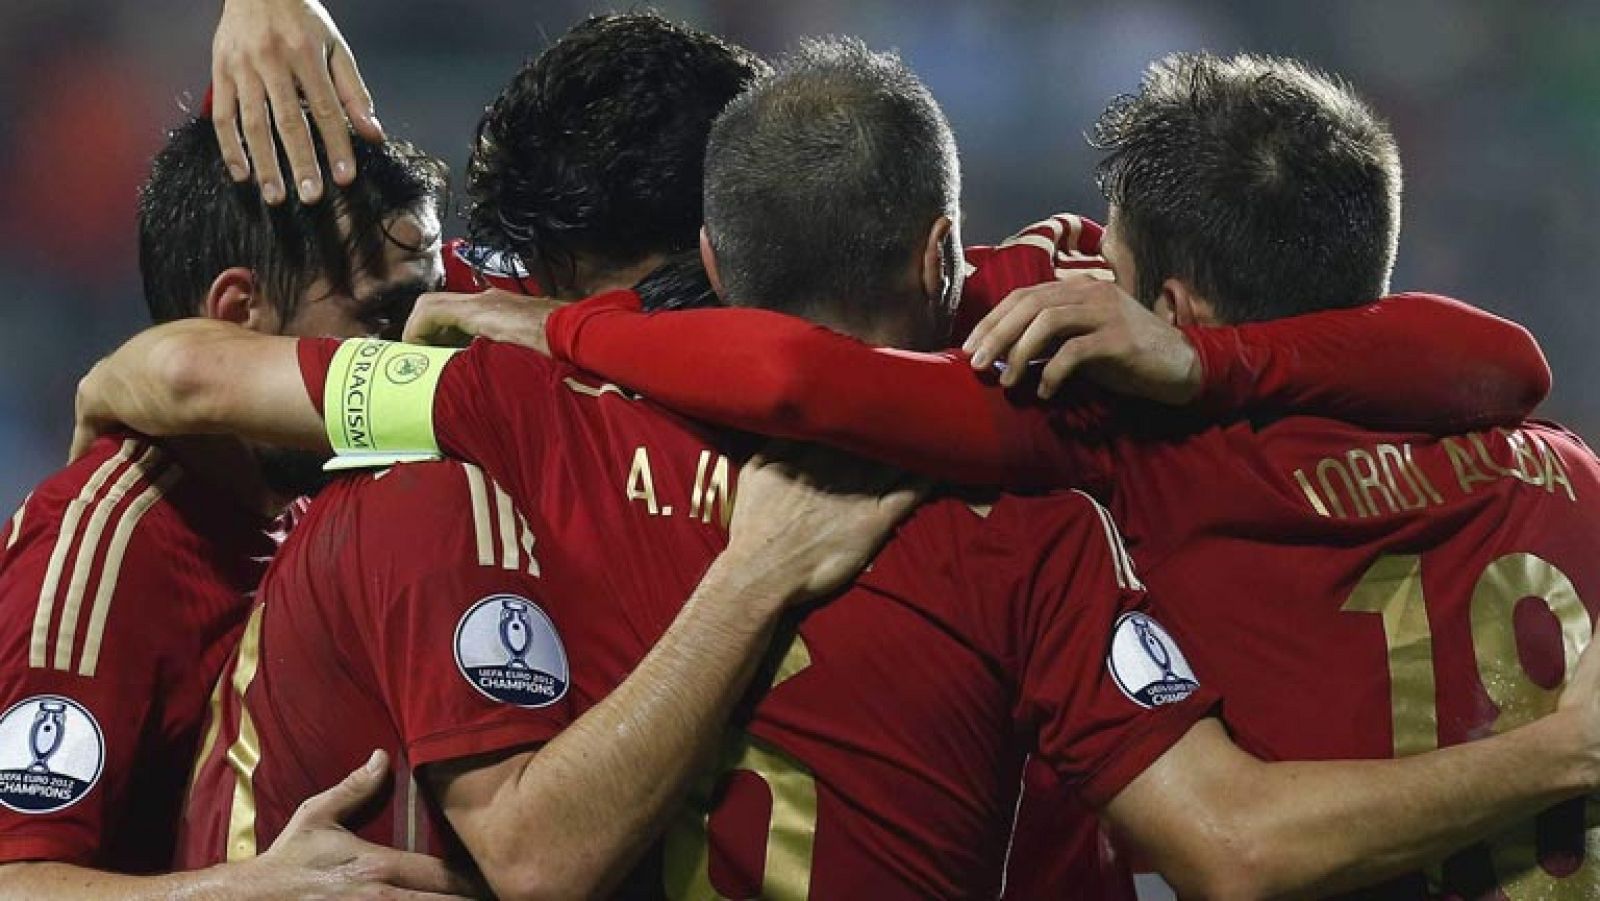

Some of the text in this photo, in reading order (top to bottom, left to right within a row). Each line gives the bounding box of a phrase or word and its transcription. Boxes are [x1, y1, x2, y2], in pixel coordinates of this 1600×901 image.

[347, 362, 371, 449] RACISM
[627, 446, 672, 516] A.
[1293, 427, 1577, 518] JORDI ALBA
[480, 677, 555, 697] CHAMPIONS
[506, 670, 531, 680] EURO
[24, 774, 48, 785] EURO
